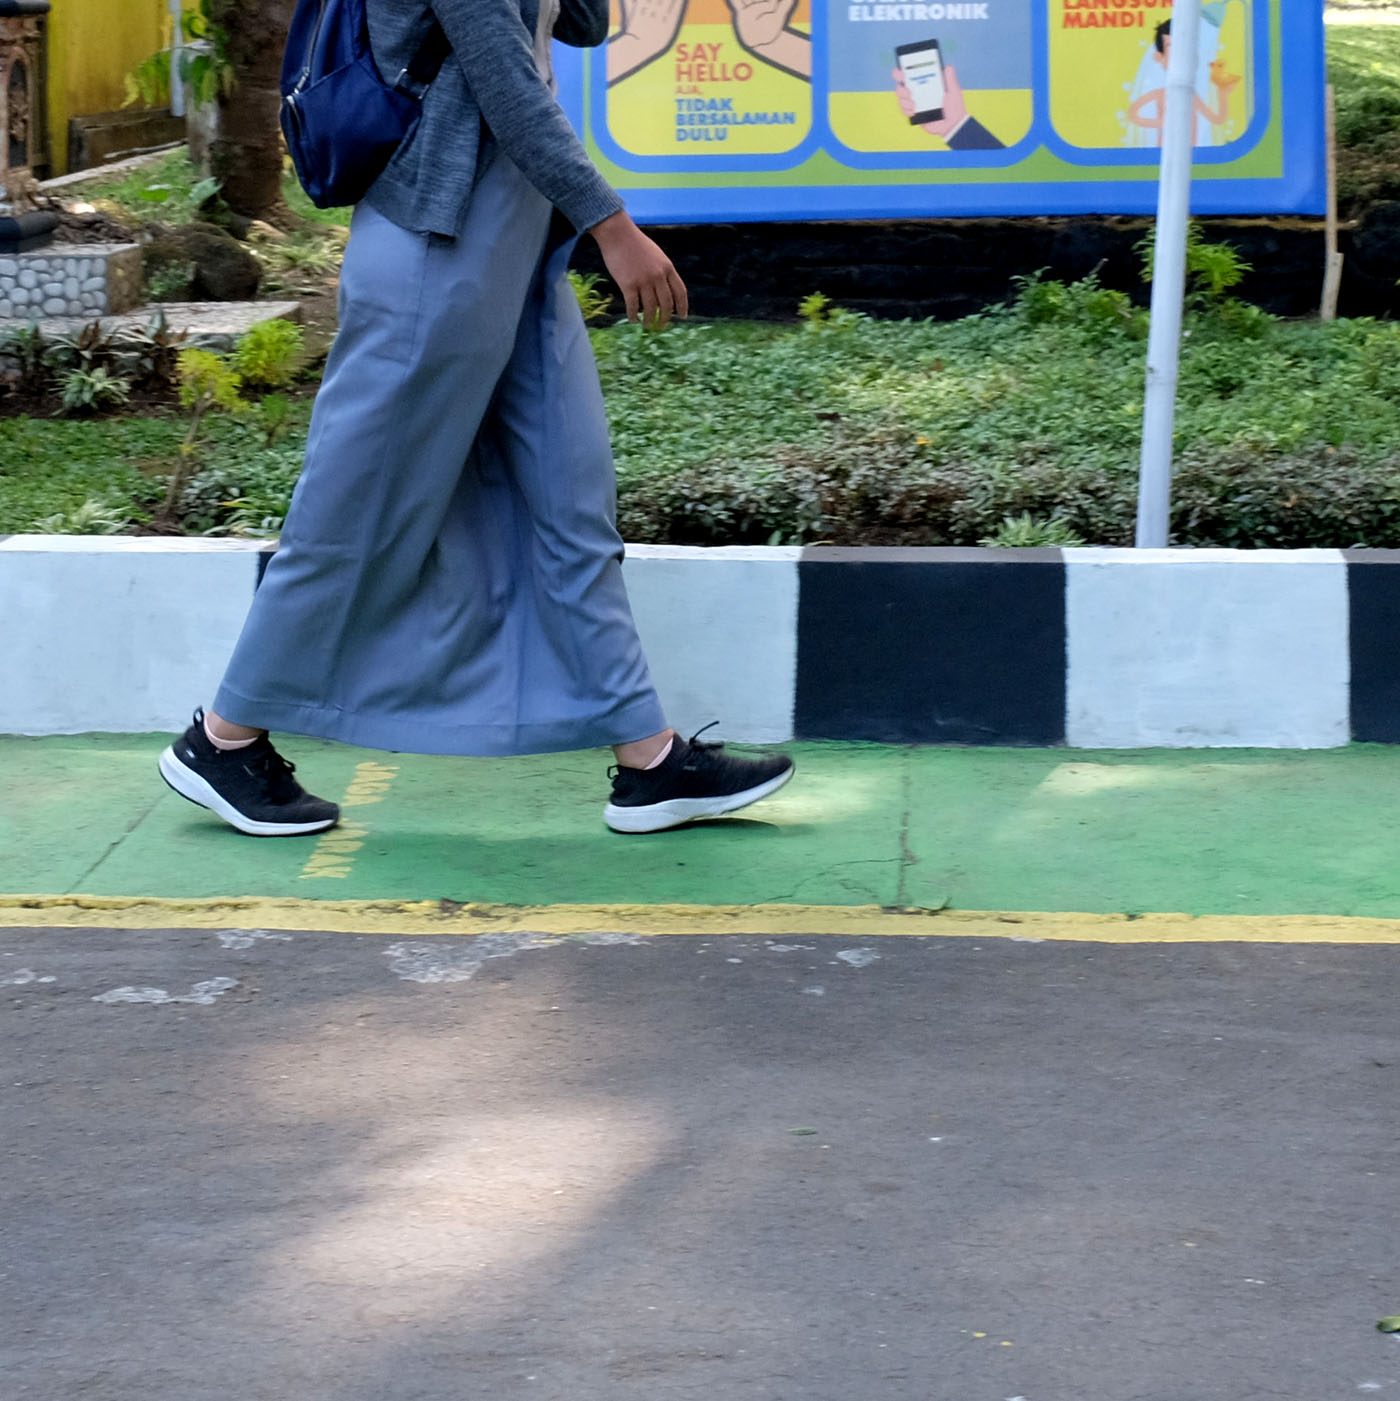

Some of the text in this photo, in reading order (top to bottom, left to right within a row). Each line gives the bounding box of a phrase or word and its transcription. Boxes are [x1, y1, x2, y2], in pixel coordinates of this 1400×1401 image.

[848, 3, 990, 21] ELEKTRONIK
[1062, 11, 1146, 28] MANDI
[676, 43, 722, 61] SAY
[676, 63, 753, 82] HELLO
[675, 98, 733, 111] TIDAK
[676, 112, 796, 126] BERSALAMAN
[676, 128, 728, 141] DULU
